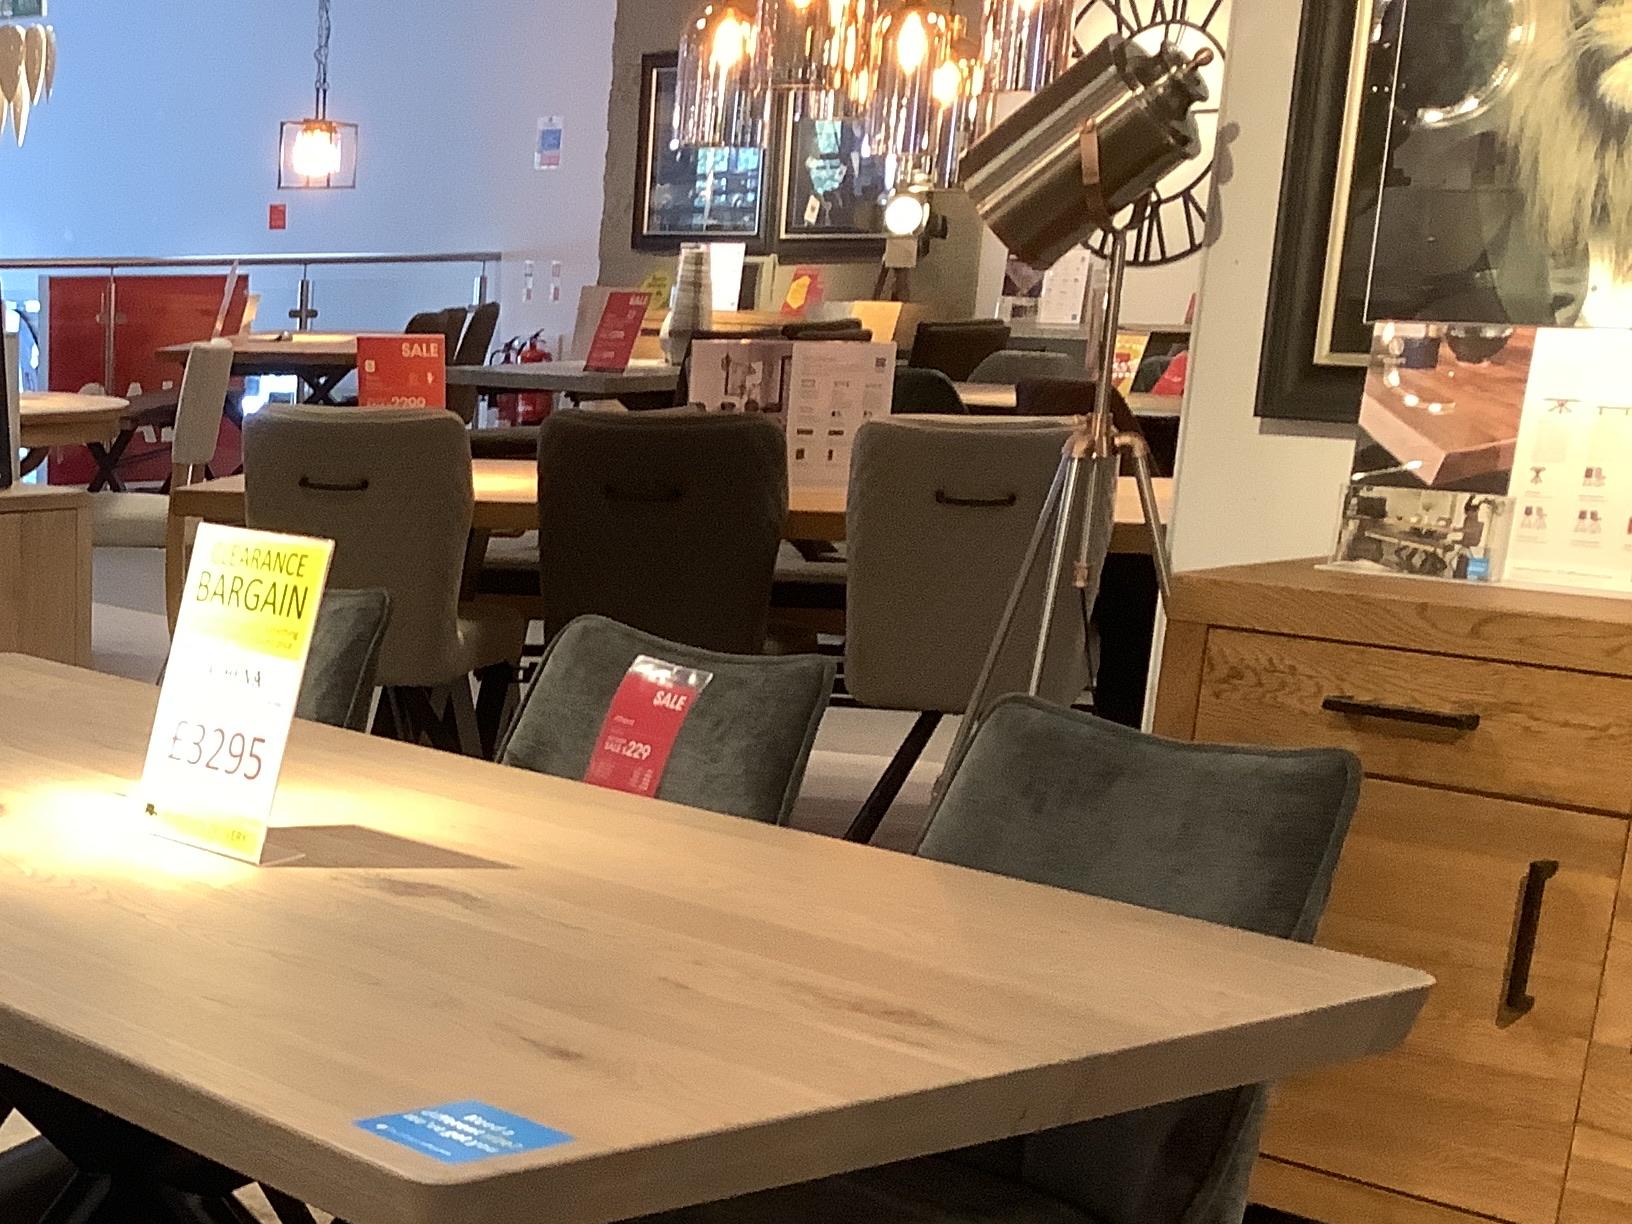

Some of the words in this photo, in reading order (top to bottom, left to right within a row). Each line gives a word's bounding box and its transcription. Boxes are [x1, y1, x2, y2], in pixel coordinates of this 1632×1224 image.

[401, 342, 439, 358] SALE
[196, 570, 309, 620] BARGAIN
[653, 690, 688, 712] SALE
[168, 720, 266, 781] £3295
